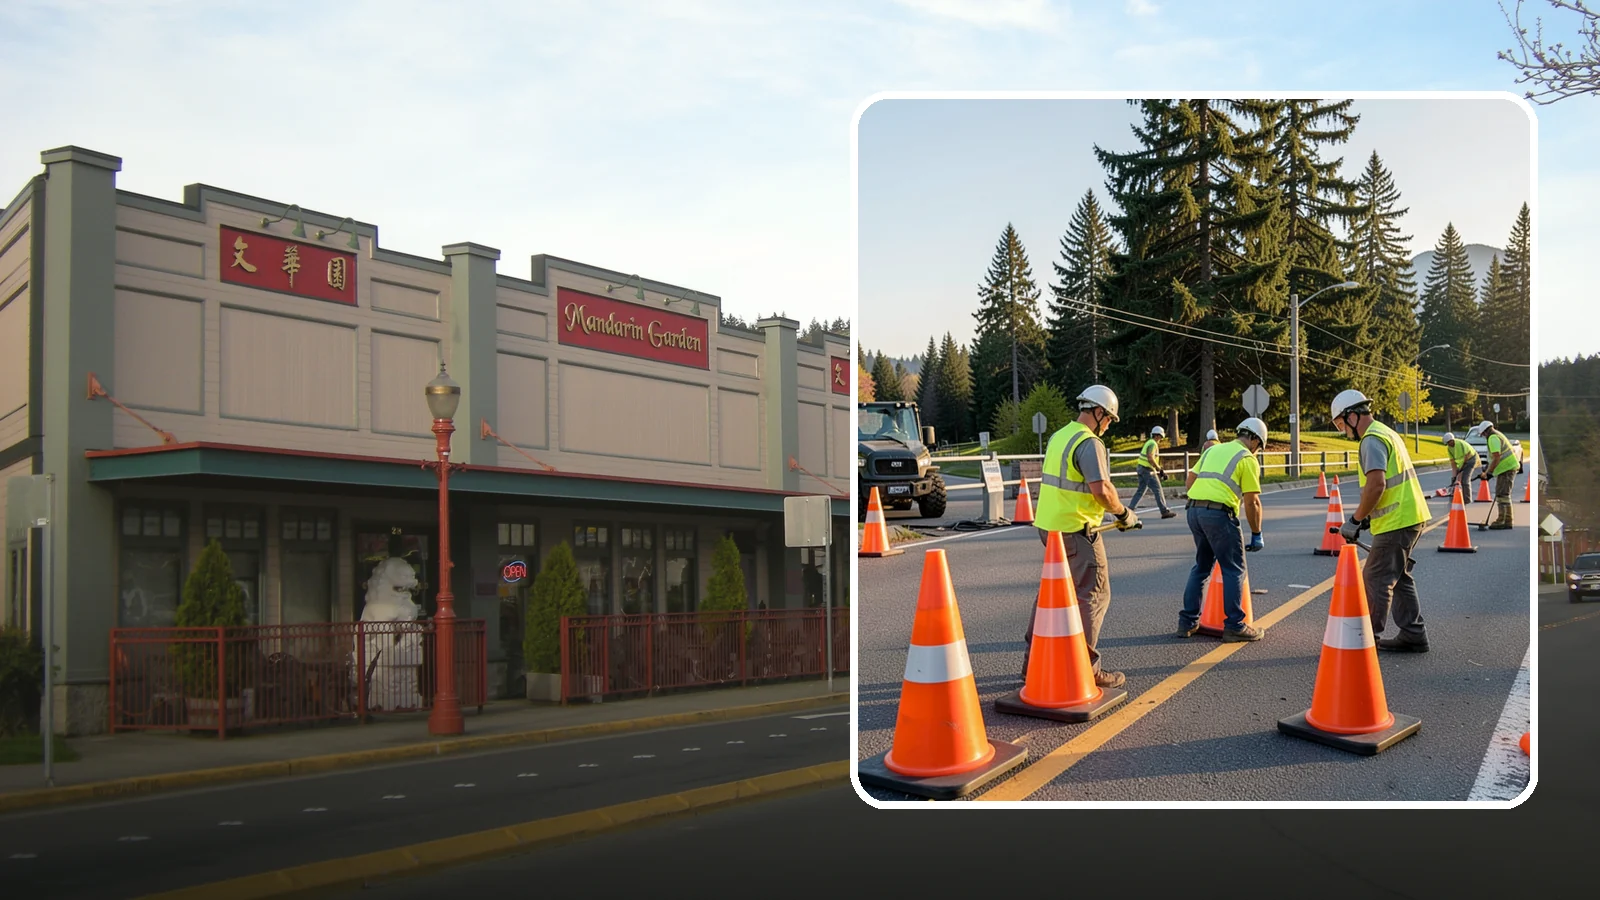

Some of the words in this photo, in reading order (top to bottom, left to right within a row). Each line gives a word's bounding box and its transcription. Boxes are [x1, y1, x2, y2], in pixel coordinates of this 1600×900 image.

[565, 303, 643, 341] Mandarin
[648, 320, 702, 352] Garden
[835, 363, 846, 386] 文
[503, 565, 527, 578] OPEN
